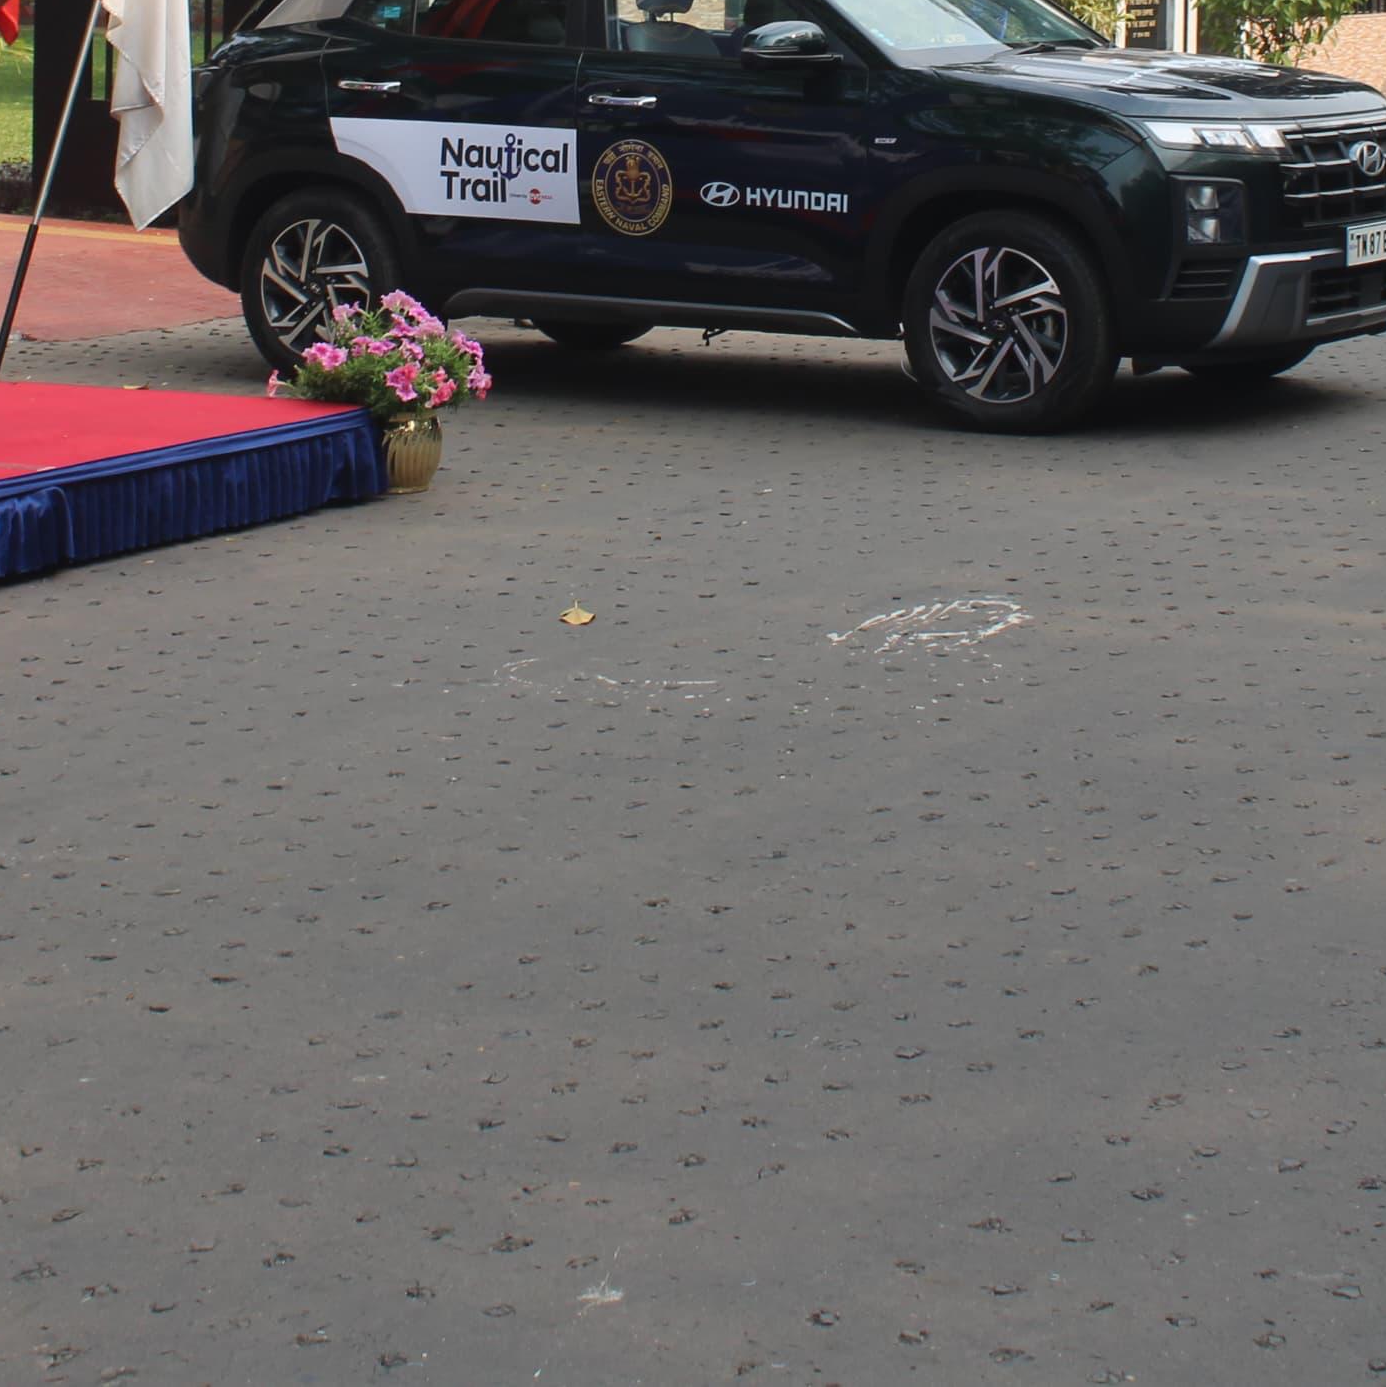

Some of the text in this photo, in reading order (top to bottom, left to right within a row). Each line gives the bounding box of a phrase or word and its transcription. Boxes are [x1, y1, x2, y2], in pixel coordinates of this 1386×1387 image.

[440, 133, 569, 178] Nautical
[440, 170, 507, 203] Trail
[595, 178, 616, 220] EASTERN
[614, 217, 648, 231] NAVAL
[647, 183, 670, 227] COMMAND
[745, 186, 849, 214] HYUNDAI
